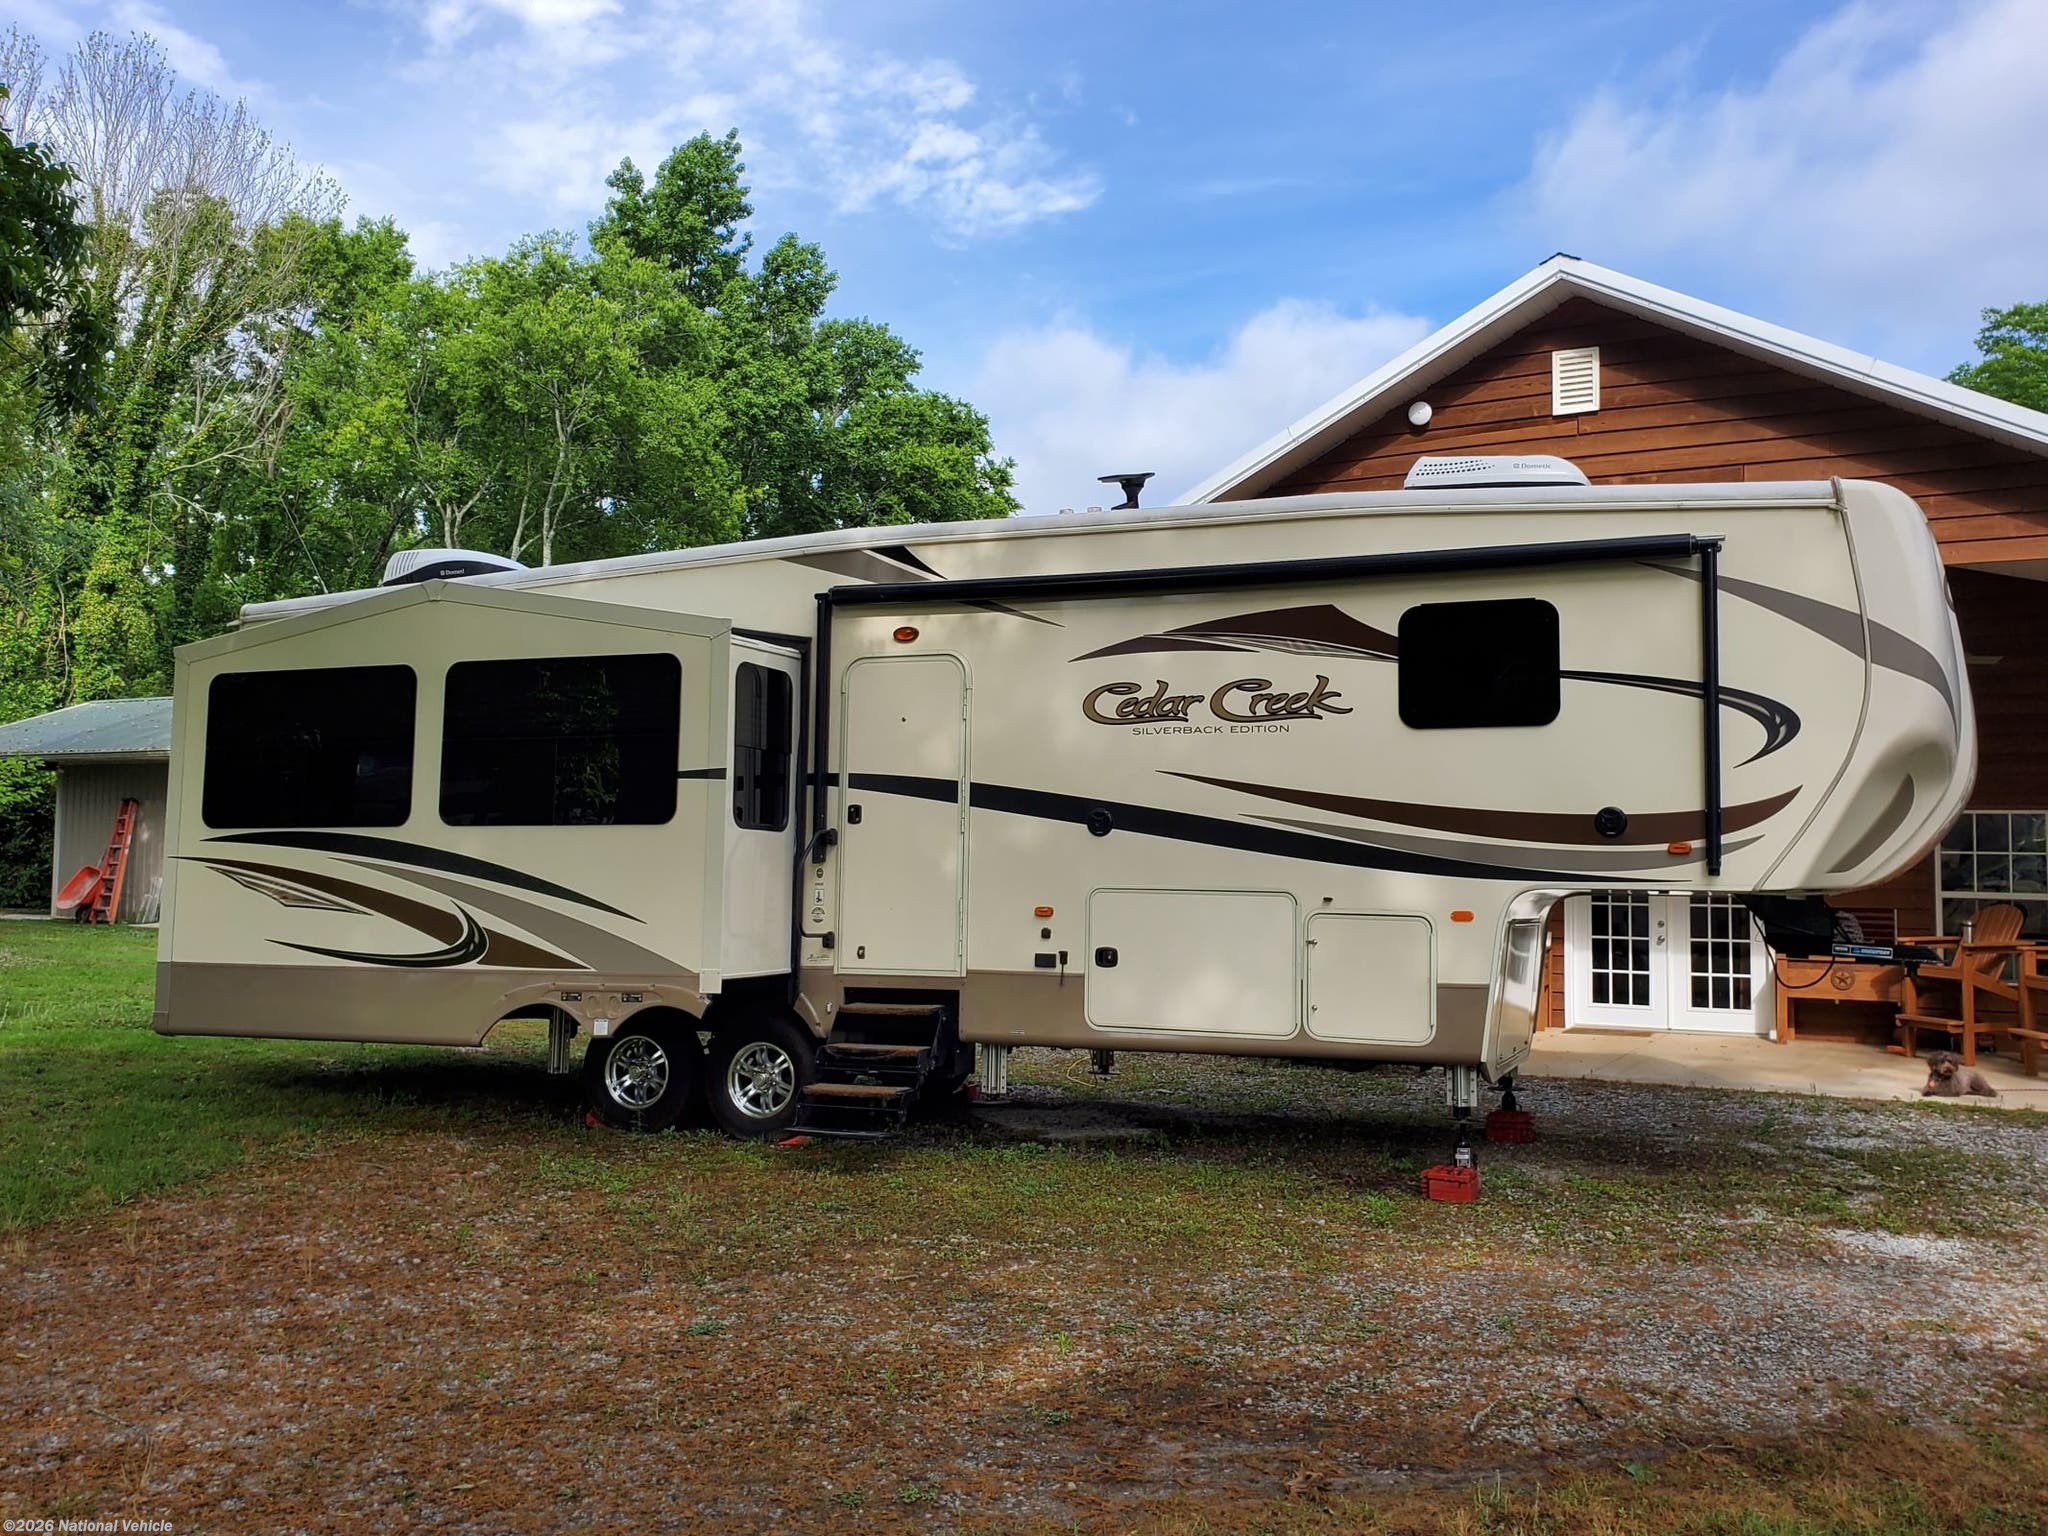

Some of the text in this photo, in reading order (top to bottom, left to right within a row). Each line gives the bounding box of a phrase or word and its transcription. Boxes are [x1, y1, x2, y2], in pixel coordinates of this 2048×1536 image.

[1082, 674, 1353, 725] Cedar Creek
[1132, 724, 1290, 736] SILVERBACK EDITION
